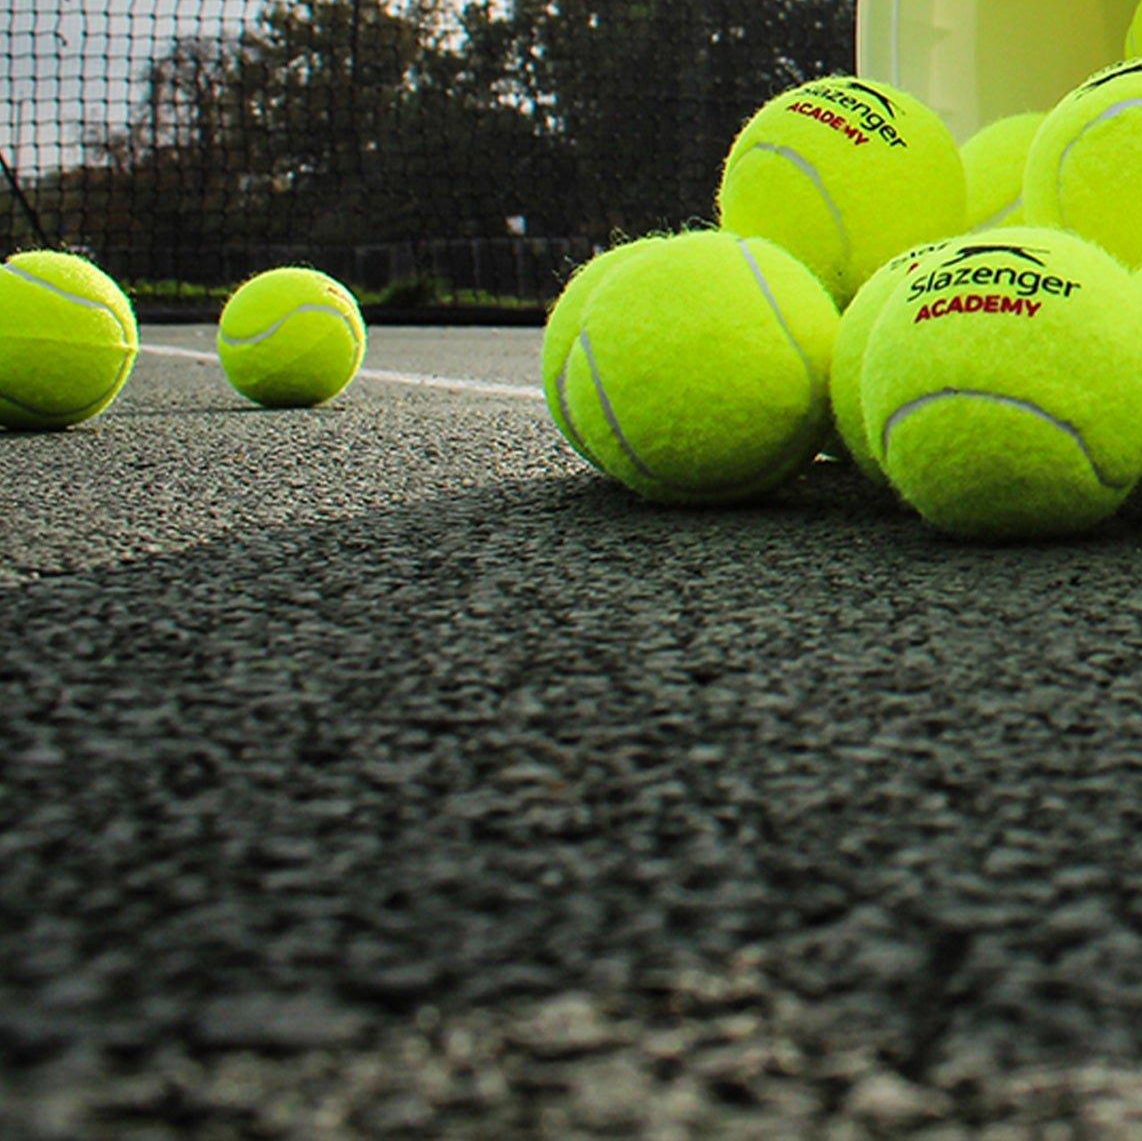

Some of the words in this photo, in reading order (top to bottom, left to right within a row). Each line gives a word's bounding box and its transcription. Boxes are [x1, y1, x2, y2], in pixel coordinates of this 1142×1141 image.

[786, 101, 869, 147] ACADEMY
[907, 266, 1081, 302] Slazenger
[914, 294, 1041, 324] ACADEMY
